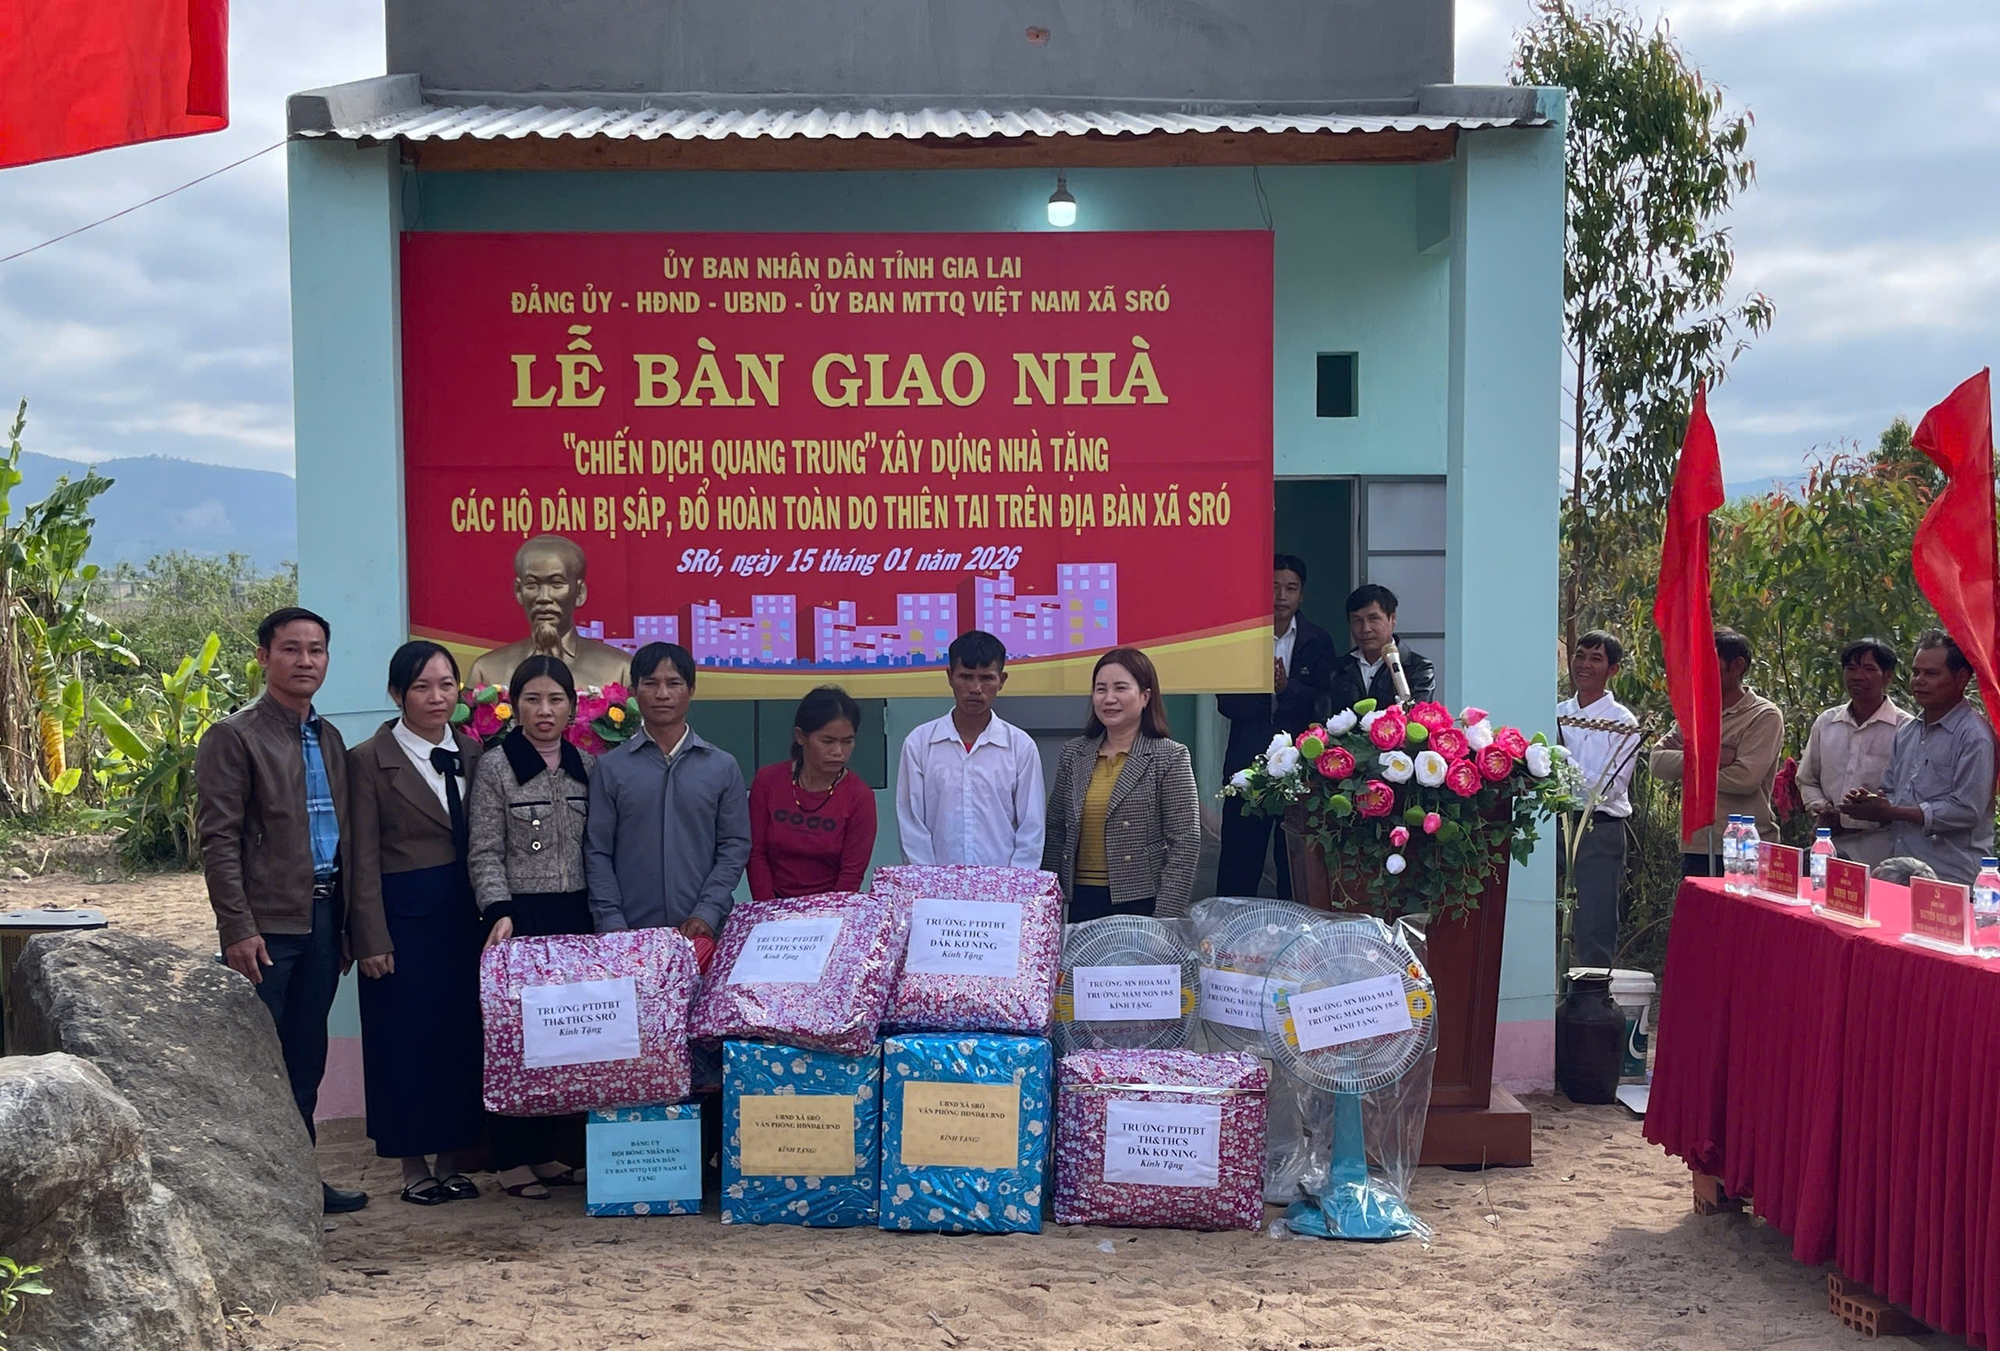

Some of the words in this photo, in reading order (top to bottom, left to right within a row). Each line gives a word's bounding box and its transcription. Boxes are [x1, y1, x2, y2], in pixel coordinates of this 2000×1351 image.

[664, 249, 693, 279] ỦY
[703, 258, 748, 279] BAN
[757, 252, 819, 279] NHÂN
[828, 252, 873, 279] DÂN
[882, 250, 933, 279] TỈNH
[942, 256, 978, 279] GIA
[987, 256, 1022, 279] LAI
[511, 284, 574, 314] ĐẢNG
[583, 284, 613, 314] ỦY
[637, 292, 700, 313] HĐND
[725, 291, 786, 313] UBND
[811, 284, 841, 314] ỦY
[849, 291, 894, 313] BAN
[903, 291, 965, 316] MTTQ
[972, 285, 1022, 316] VIỆT
[1032, 291, 1080, 312] NAM
[1088, 285, 1117, 312] XÃ
[1125, 284, 1170, 312] SRÓ
[511, 325, 605, 407] LỄ
[633, 337, 784, 407] BÀN
[812, 351, 986, 407] GIAO
[1013, 335, 1168, 405] NHÀ
[652, 439, 703, 482] DỊCH
[711, 438, 786, 480] QUANG
[880, 429, 923, 474] XÂY
[932, 432, 991, 481] DỰNG
[999, 429, 1043, 473] NHÀ
[1050, 431, 1109, 482] TẶNG
[451, 488, 495, 533] CÁC
[503, 488, 533, 539] HỘ
[541, 488, 586, 532] DÂN
[594, 496, 616, 539] BỊ
[623, 487, 673, 538] SẬP,
[679, 477, 709, 531] ĐỔ
[718, 487, 776, 531] HOÀN
[783, 487, 840, 531] TOÀN
[848, 496, 878, 530] DO
[884, 486, 949, 530] THIÊN
[954, 494, 989, 529] TAI
[995, 485, 1052, 529] TRÊN
[1060, 493, 1096, 536] ĐỊA
[1103, 484, 1146, 528] BÀN
[1153, 484, 1181, 527] XÃ
[1188, 482, 1231, 527] SRÓ
[676, 549, 724, 578] SRó,
[730, 548, 783, 577] ngày
[786, 548, 818, 572] 15
[819, 548, 881, 576] tháng
[882, 547, 909, 572] 01
[915, 548, 962, 571] năm
[963, 545, 1023, 571] 2026
[969, 920, 1006, 930] PTDTBT
[940, 929, 989, 938] TH&THCS
[971, 941, 997, 950] NING
[941, 950, 961, 958] Kính
[963, 951, 984, 961] Tặng
[1138, 979, 1155, 987] HOA
[1155, 978, 1171, 986] MAI
[1142, 990, 1159, 998] NON
[1344, 997, 1358, 1007] MN
[1358, 994, 1375, 1005] HOA
[1375, 990, 1394, 1000] MAI
[537, 1003, 580, 1016] TRƯỜNG
[582, 1000, 621, 1012] PTDTBT
[1109, 1002, 1130, 1010] KÍNH
[1366, 1005, 1383, 1016] NON
[542, 1015, 594, 1027] TH&THCS
[595, 1011, 617, 1022] SRÓ
[559, 1027, 579, 1037] Kính
[581, 1026, 602, 1036] Tặng
[1333, 1022, 1356, 1033] KÍNH
[1121, 1122, 1165, 1134] TRƯỜNG
[1167, 1125, 1206, 1136] PTDTBT
[1138, 1135, 1189, 1146] TH&THCS
[1170, 1149, 1197, 1159] NING
[1140, 1159, 1161, 1168] Kính
[1162, 1160, 1184, 1171] Tặng
